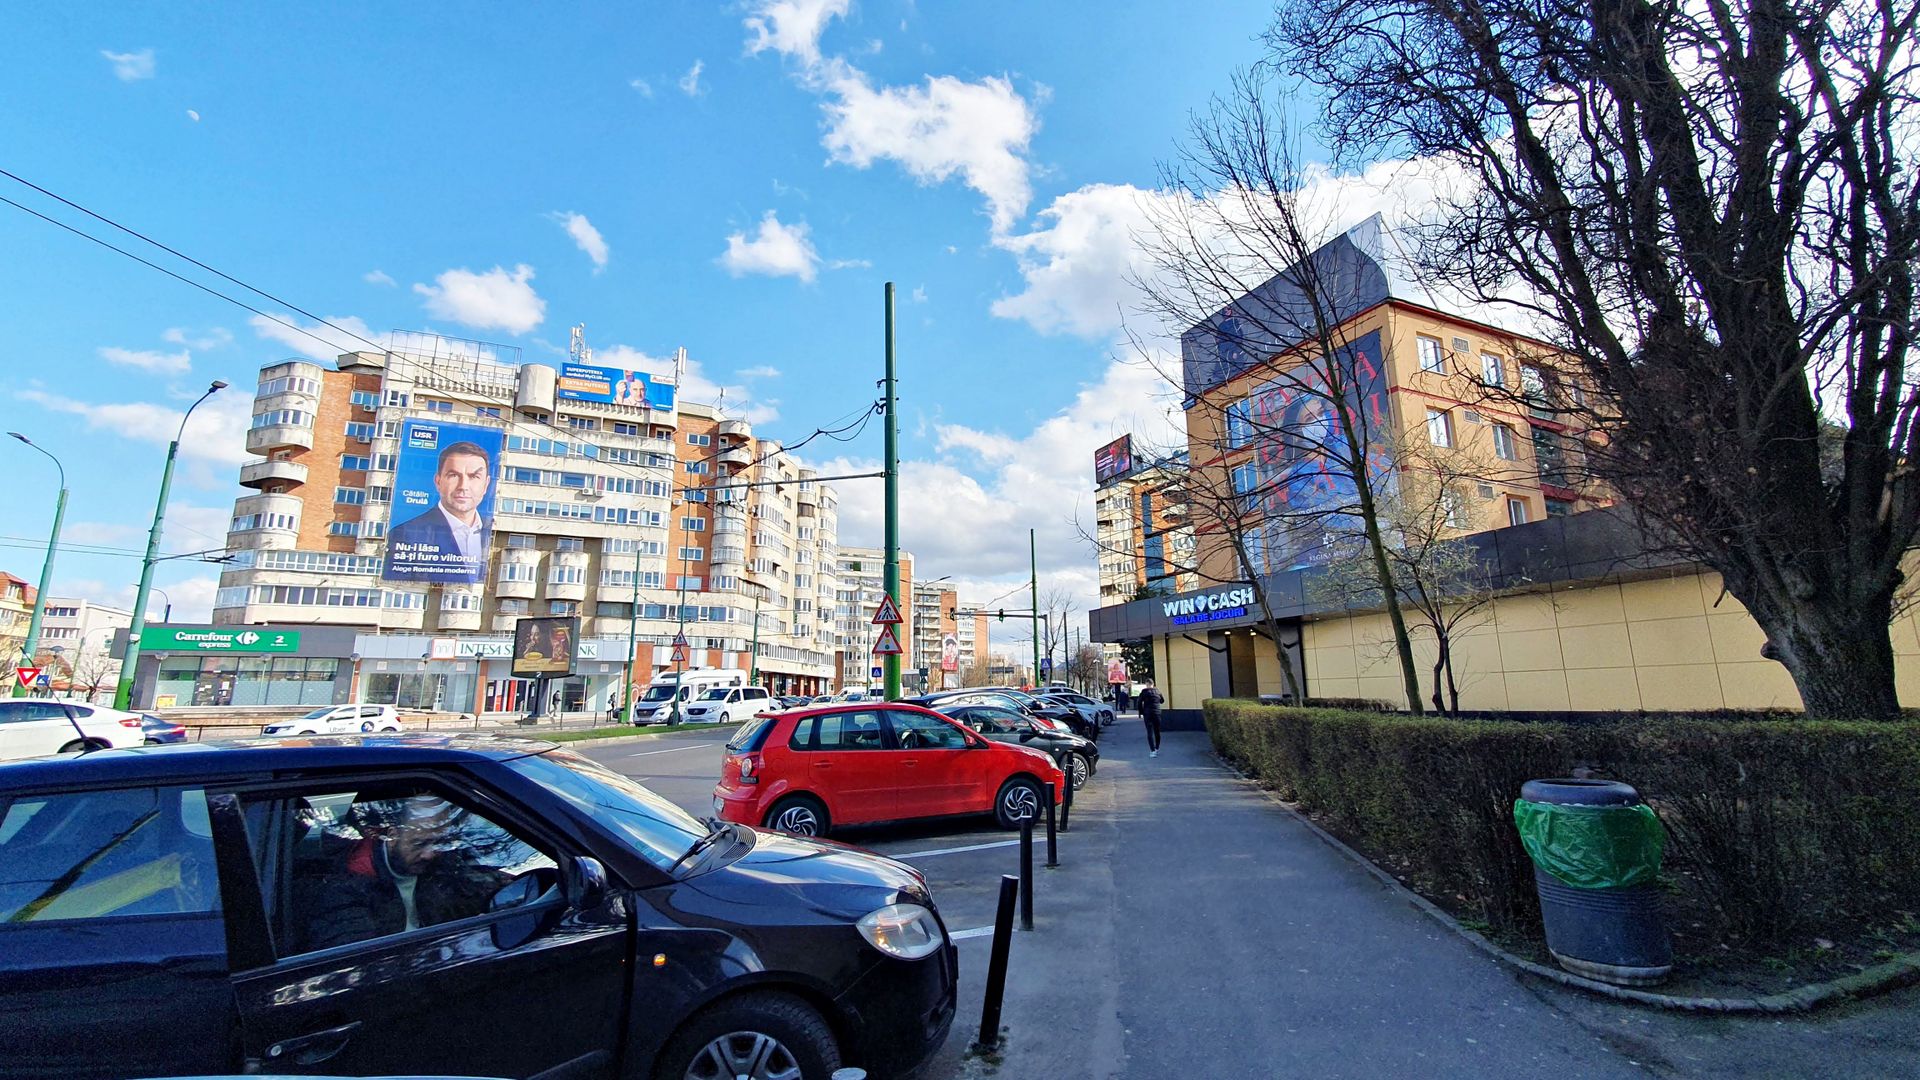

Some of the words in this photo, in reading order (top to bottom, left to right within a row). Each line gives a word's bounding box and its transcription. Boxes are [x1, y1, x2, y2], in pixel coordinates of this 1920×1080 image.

[414, 431, 432, 439] USR
[405, 497, 429, 505] Drulă
[395, 542, 417, 551] Nu-i
[418, 543, 440, 553] lăsa
[417, 553, 439, 562] fure
[392, 565, 412, 574] Alege
[1163, 599, 1195, 617] WIN
[1206, 586, 1255, 611] CASH
[1173, 615, 1196, 625] SALA
[1197, 613, 1209, 622] DE
[1209, 607, 1245, 621] JOCURI
[175, 631, 234, 641] Carrefour
[275, 635, 285, 644] 2
[459, 643, 501, 655] INTESA
[578, 644, 597, 656] NK
